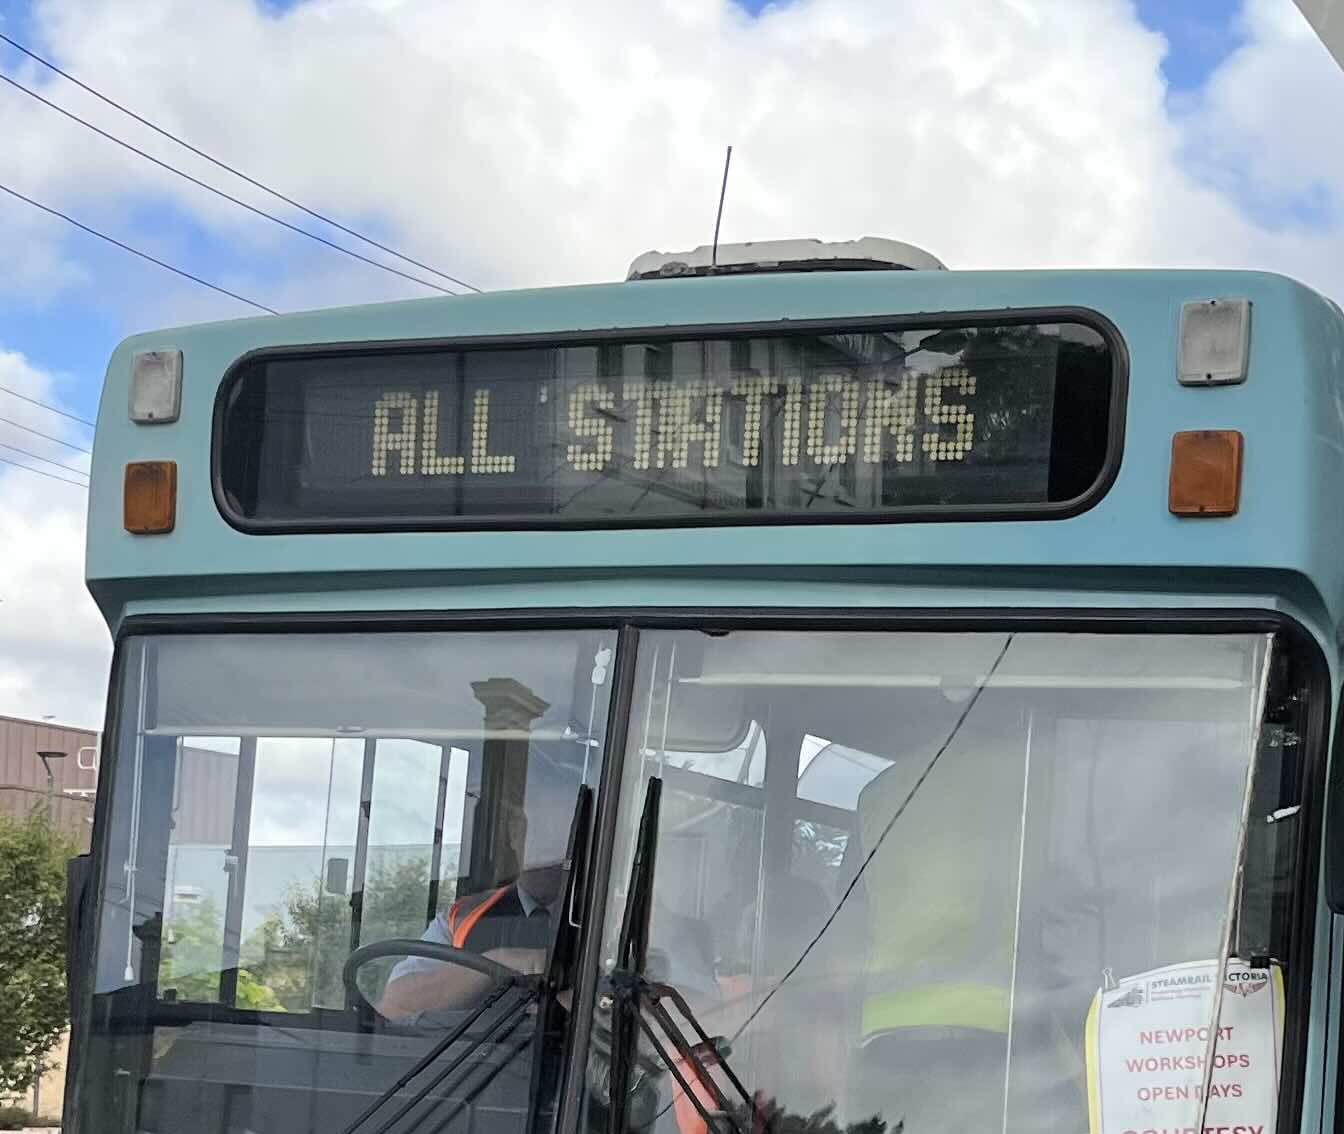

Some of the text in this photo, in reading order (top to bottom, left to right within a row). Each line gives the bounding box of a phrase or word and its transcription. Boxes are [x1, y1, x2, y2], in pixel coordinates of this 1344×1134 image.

[372, 366, 977, 476] ALL STATIONS
[1151, 975, 1212, 989] STEAMRAIL
[1140, 1026, 1233, 1044] NEWPORT
[1127, 1054, 1250, 1072] WORKSHOPS
[1137, 1086, 1189, 1101] OPEN
